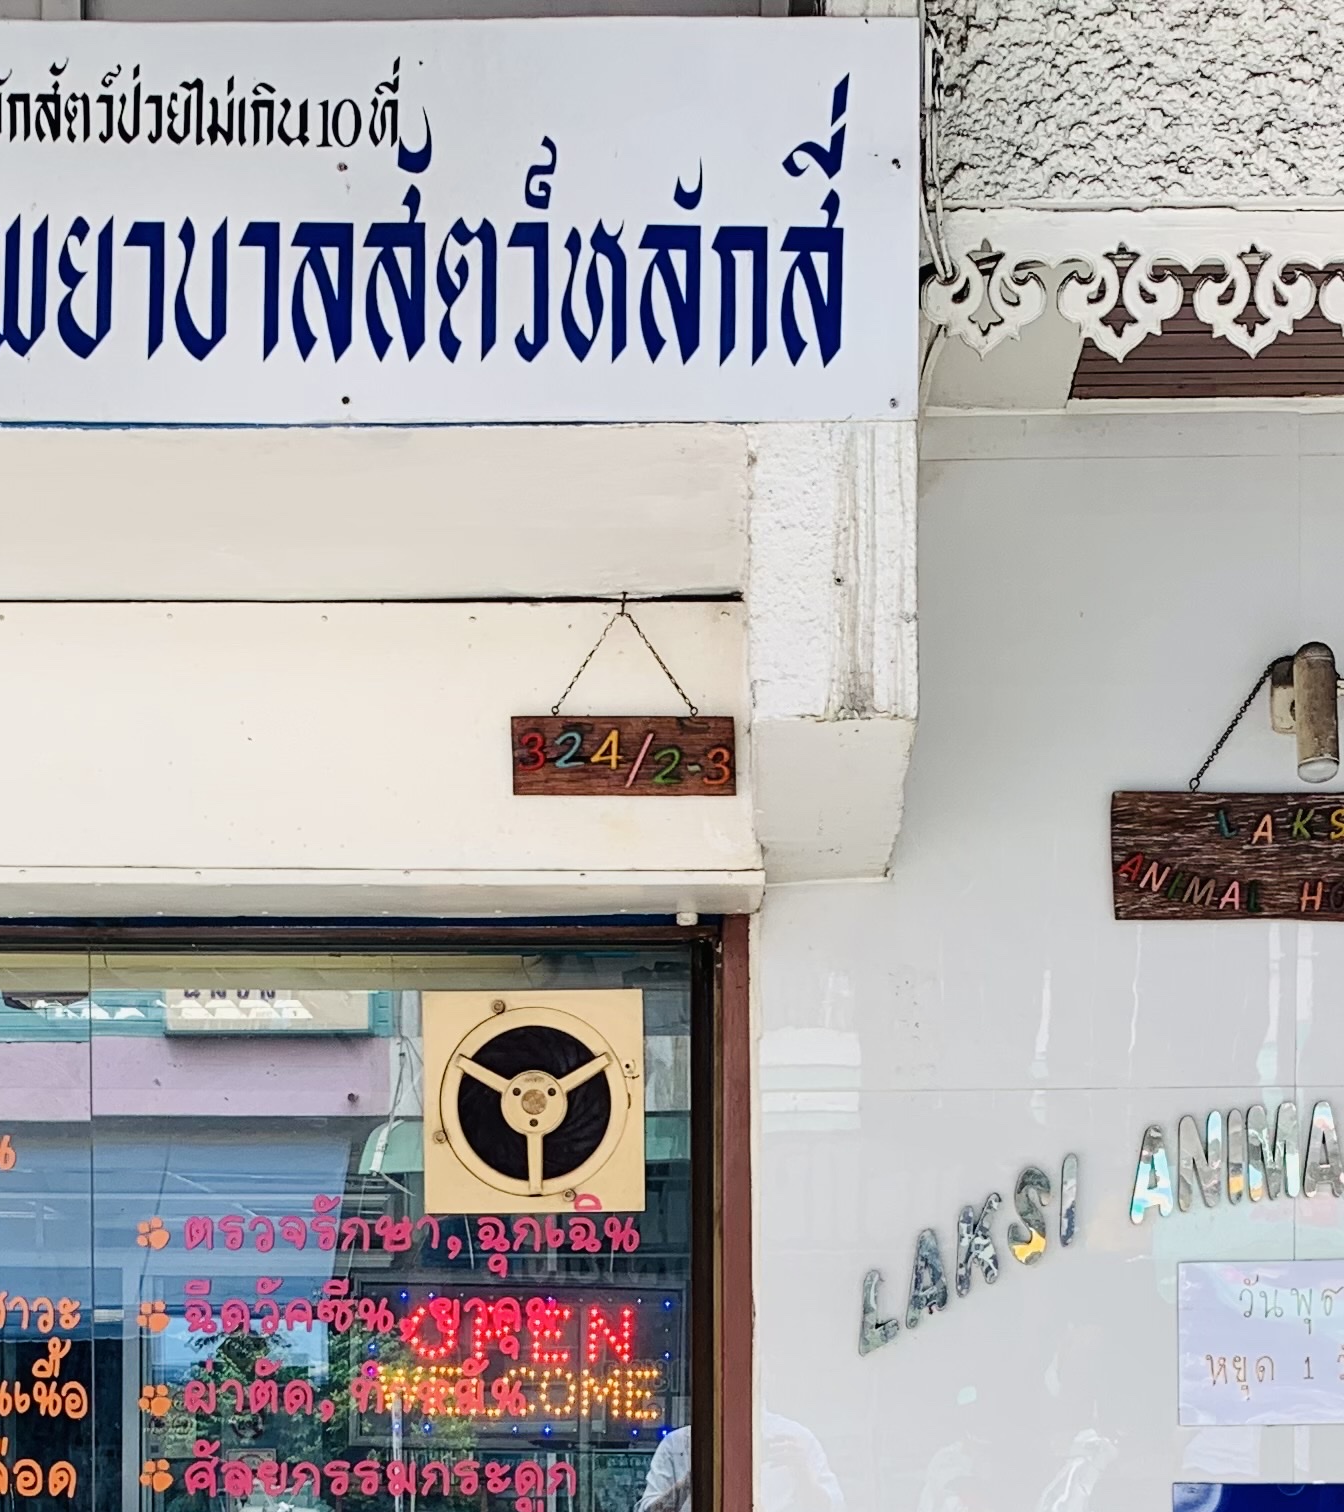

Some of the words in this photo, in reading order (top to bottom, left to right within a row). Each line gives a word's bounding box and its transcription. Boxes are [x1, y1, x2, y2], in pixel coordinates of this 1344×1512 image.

[517, 728, 732, 789] 324/2-3
[1117, 850, 1263, 914] ANIMAL
[856, 1152, 1082, 1357] LAKSI
[1205, 1354, 1275, 1401] หยุด
[1303, 1356, 1315, 1380] 1
